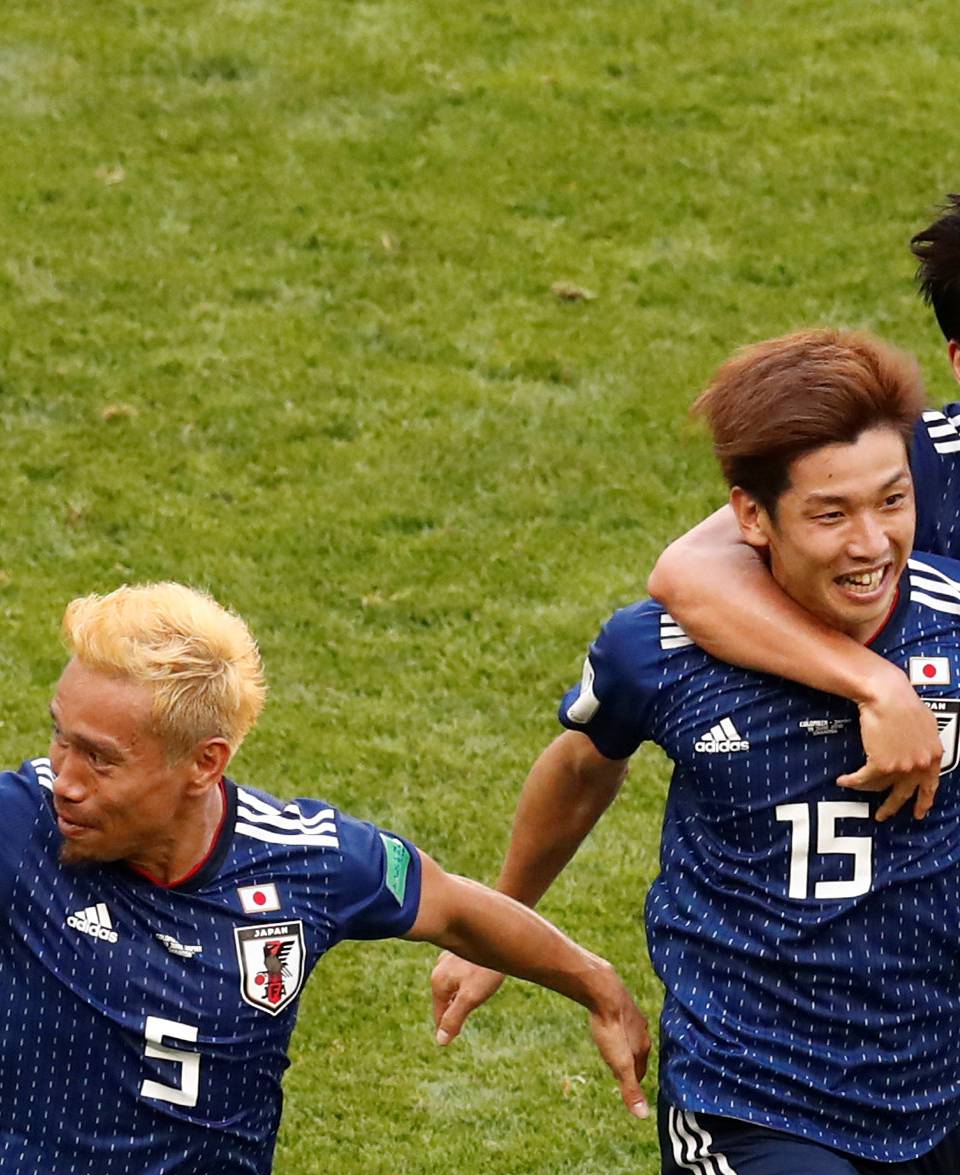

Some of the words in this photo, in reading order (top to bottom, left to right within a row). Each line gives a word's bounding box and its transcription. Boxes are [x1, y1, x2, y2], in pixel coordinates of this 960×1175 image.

[695, 740, 750, 753] adidas
[775, 801, 873, 900] 15
[66, 915, 119, 944] adidas
[253, 926, 288, 938] JAPAN
[140, 1015, 201, 1108] 5
